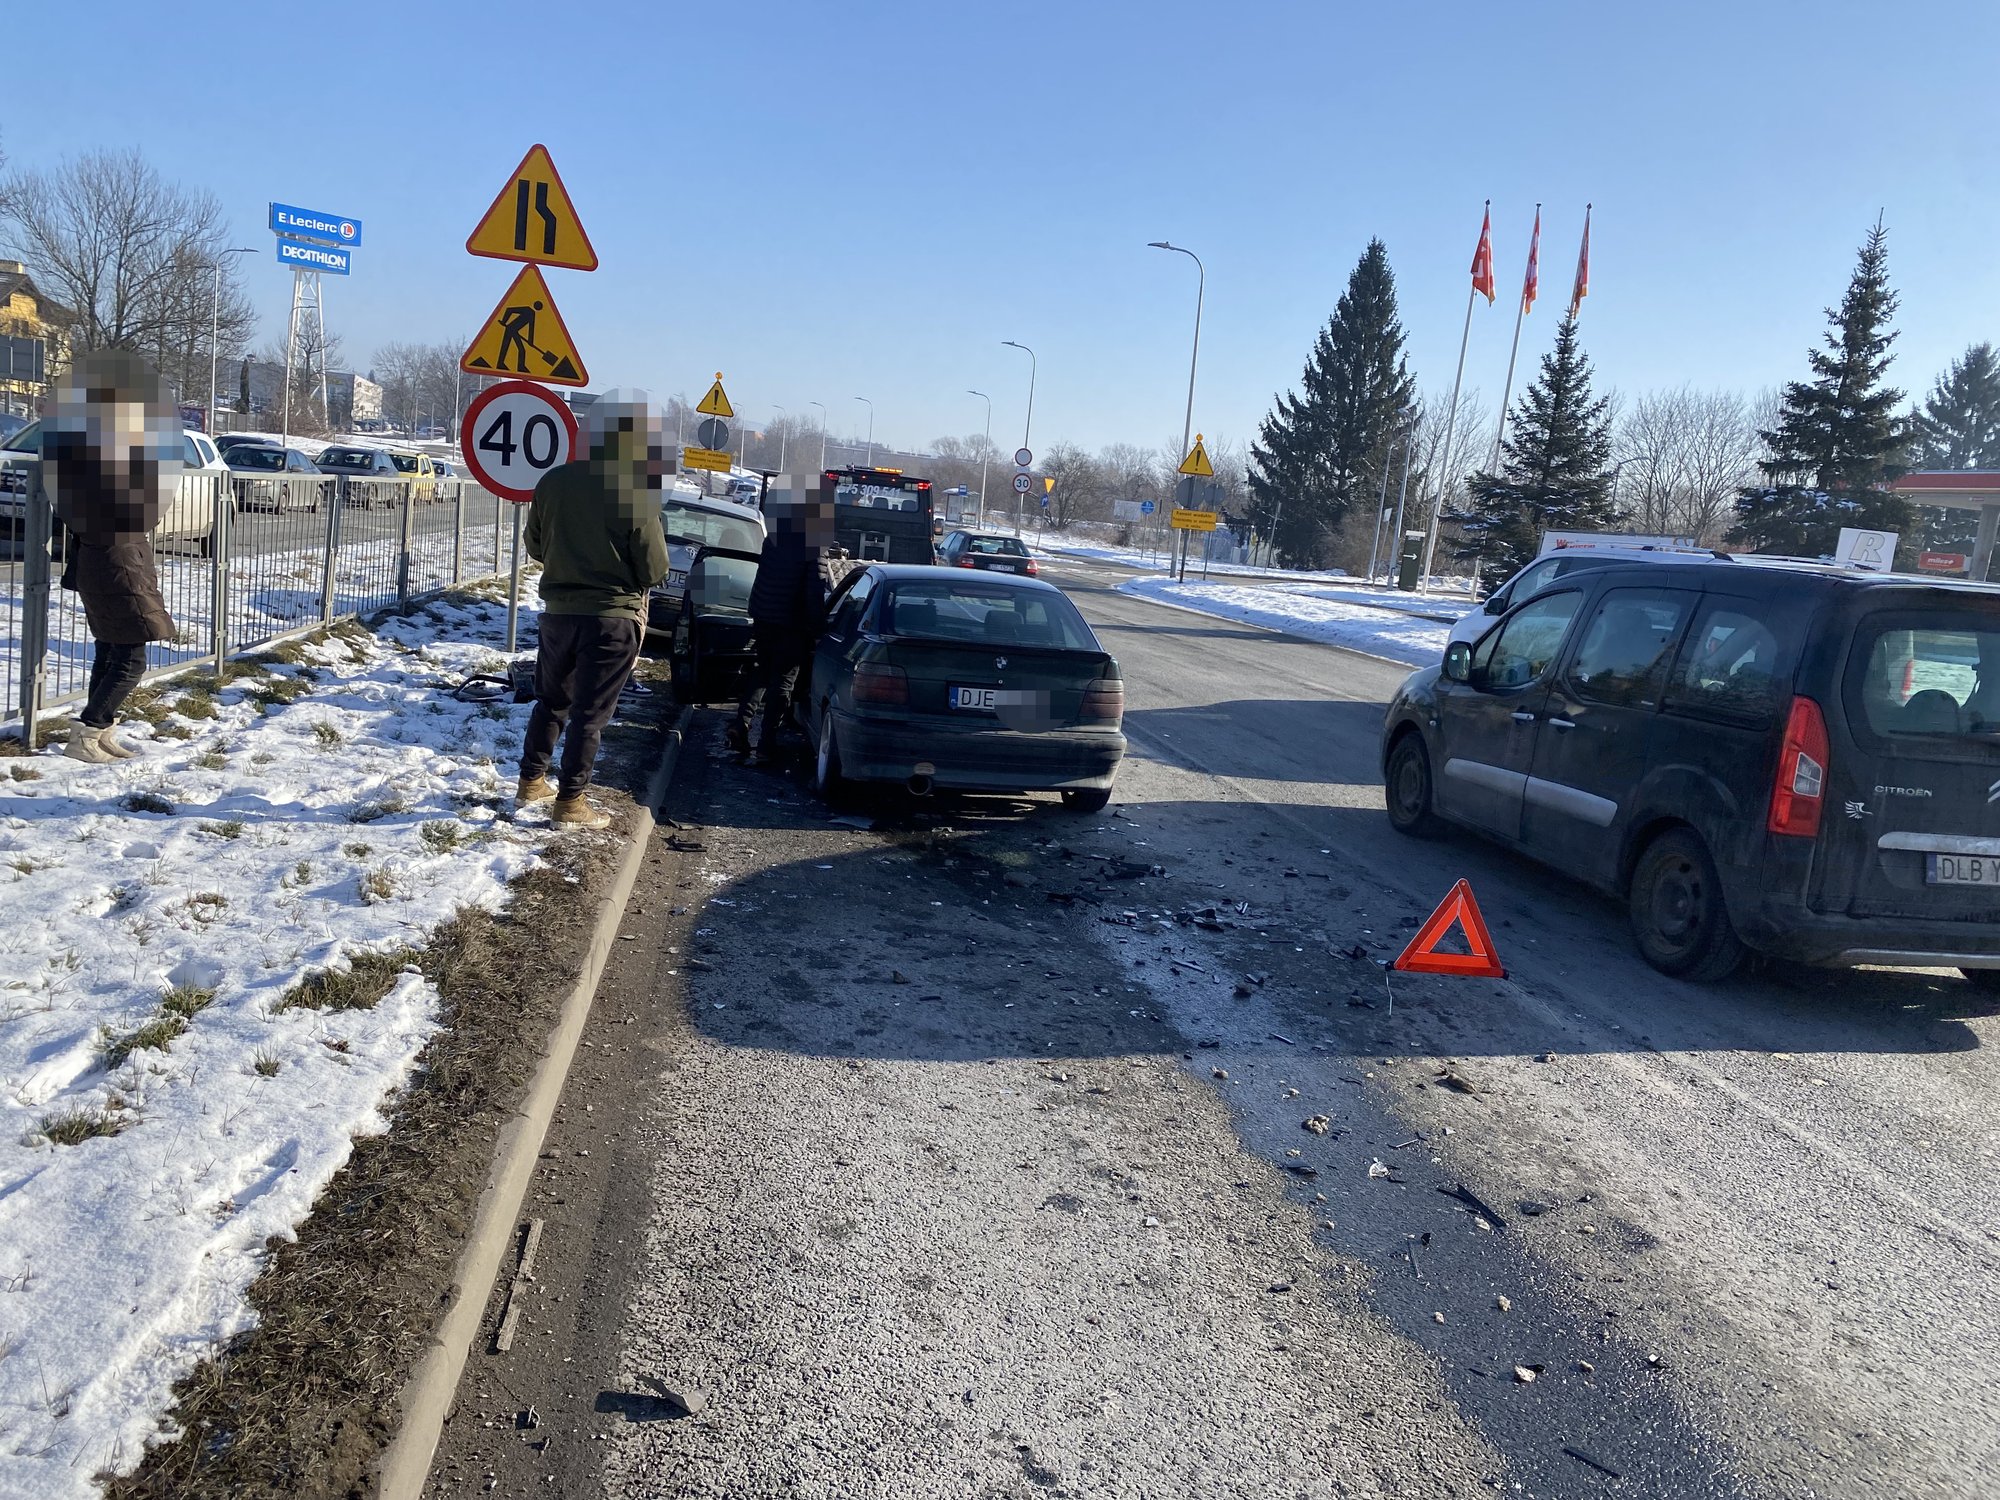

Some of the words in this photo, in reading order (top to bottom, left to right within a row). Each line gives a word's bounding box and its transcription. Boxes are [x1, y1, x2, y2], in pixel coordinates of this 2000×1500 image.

[278, 212, 337, 232] E.Leclerc
[282, 245, 346, 267] DECATHLON
[479, 410, 559, 469] 40
[860, 484, 880, 496] 309
[1016, 479, 1029, 488] 30
[1848, 531, 1886, 563] R
[961, 689, 994, 707] DJE
[1942, 858, 1982, 881] DLB
